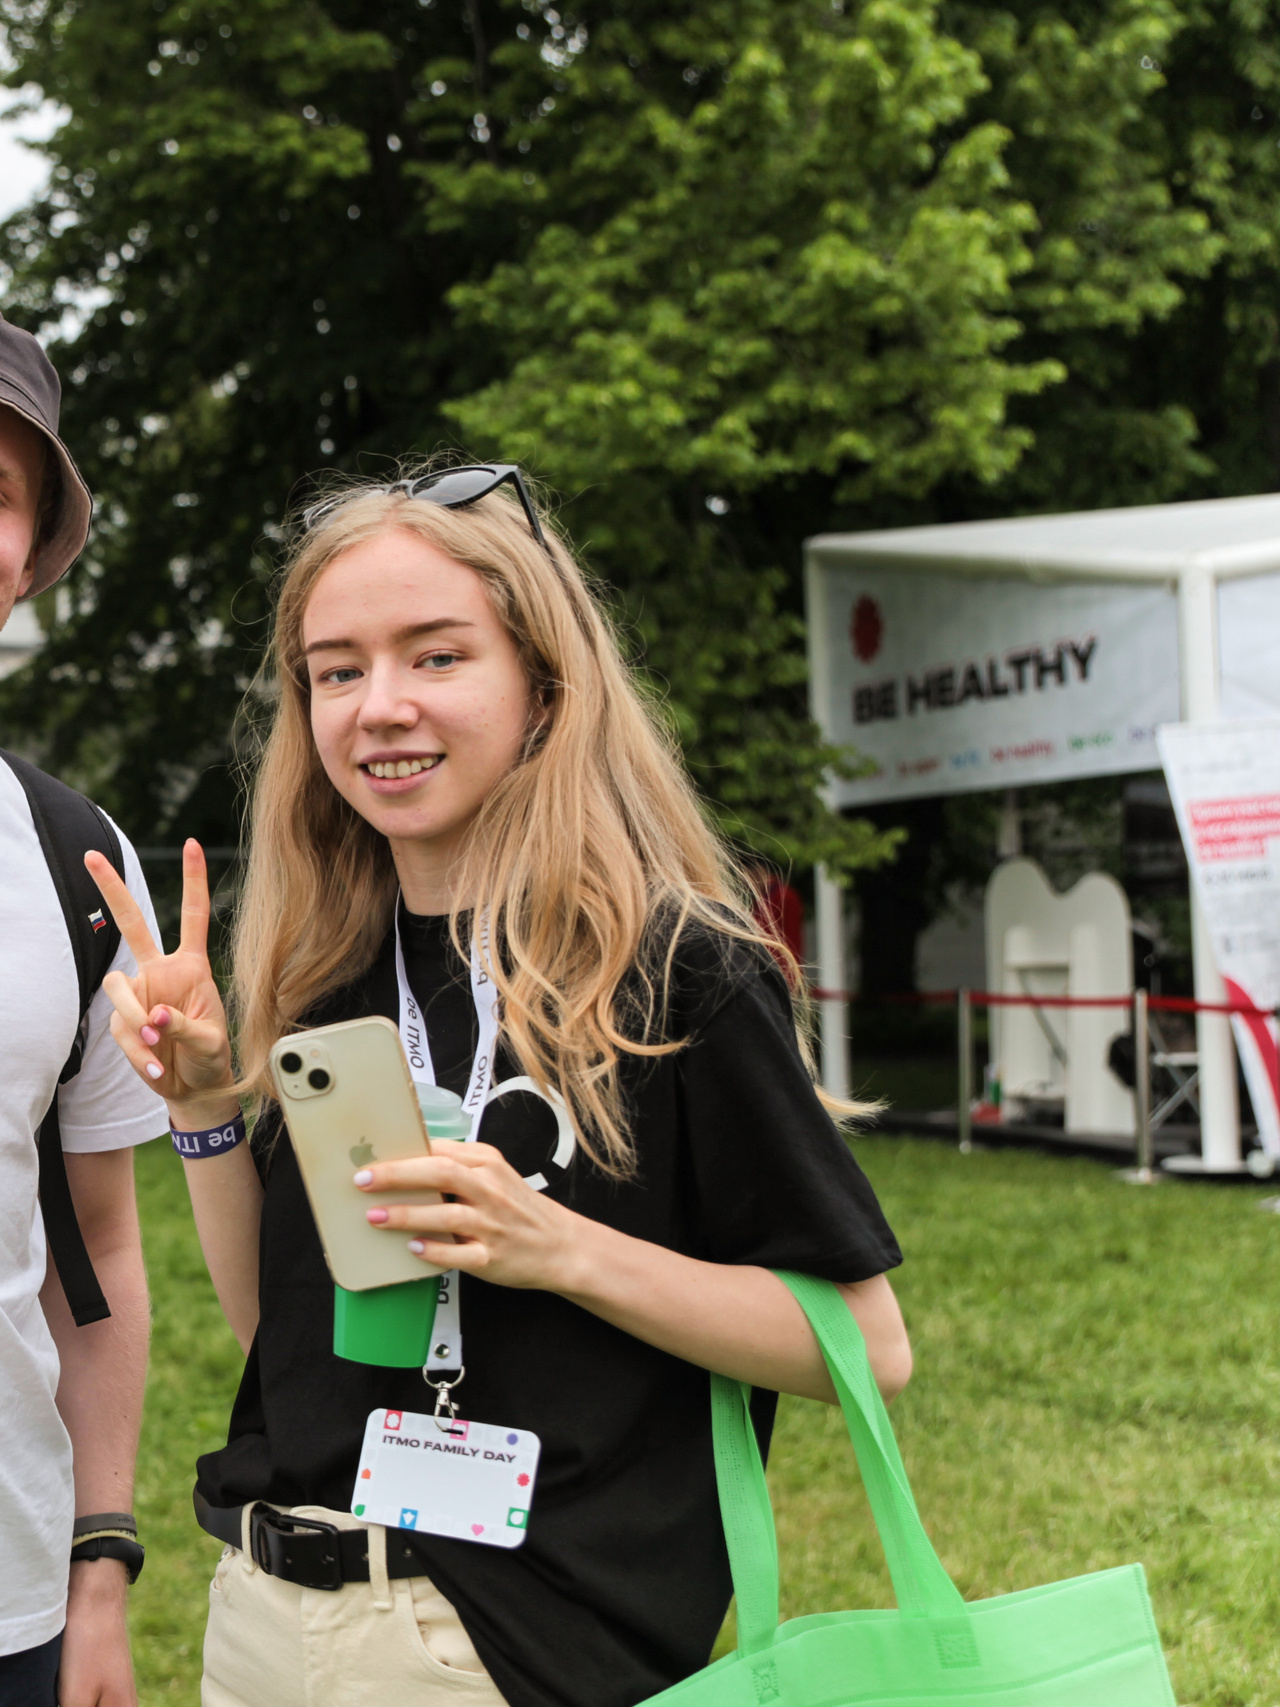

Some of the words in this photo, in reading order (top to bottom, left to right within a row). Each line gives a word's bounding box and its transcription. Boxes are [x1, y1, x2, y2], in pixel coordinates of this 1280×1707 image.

[853, 681, 898, 725] BE
[907, 636, 1098, 716] HEALTHY
[406, 996, 418, 1020] be
[407, 1024, 425, 1069] ITMO
[468, 1055, 488, 1107] ITMO
[208, 1125, 237, 1147] be
[382, 1434, 421, 1448] ITMO
[423, 1440, 480, 1457] FAMILY
[483, 1450, 517, 1463] DAY
